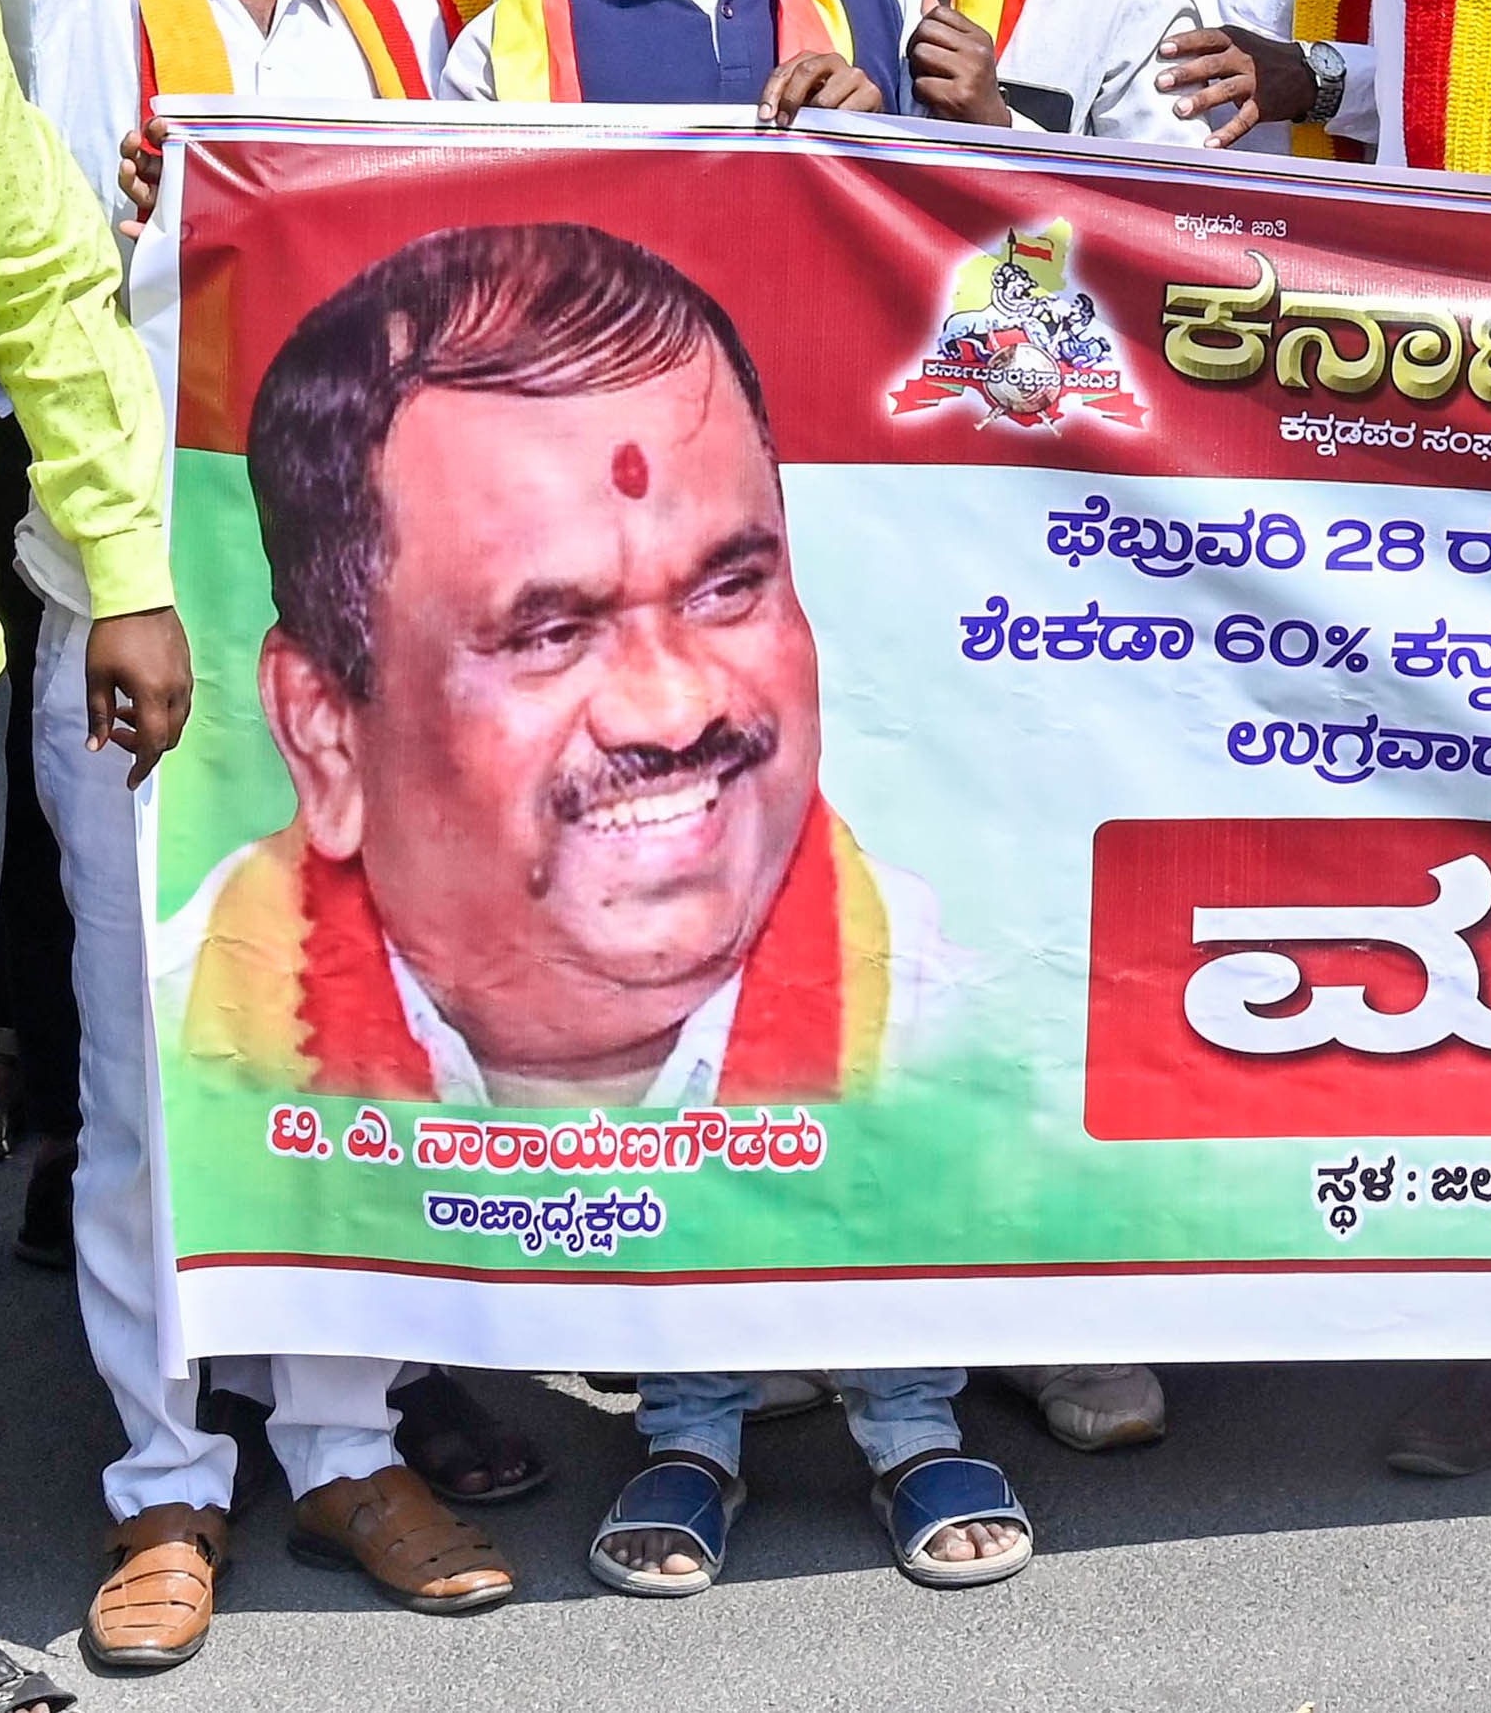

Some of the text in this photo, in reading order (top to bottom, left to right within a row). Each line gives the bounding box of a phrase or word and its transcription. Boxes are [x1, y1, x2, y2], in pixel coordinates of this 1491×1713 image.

[1174, 213, 1287, 240] ಕನ್ನಡವೇ ಜಾತಿ
[925, 361, 1003, 383] ಕರ್ನಾಟಕ
[1280, 413, 1415, 456] ಕನ್ನಡಪರ
[1046, 495, 1307, 578] ಫೆಬ್ರುವರಿ
[1324, 519, 1426, 573] 28
[960, 595, 1196, 662] ಶೇಕಡಾ
[1213, 613, 1372, 673] 60%
[273, 1108, 328, 1155] ಟಿ.
[419, 1109, 820, 1171] ನಾರಾಯಣಗೌಡರು
[428, 1190, 663, 1254] ರಾಜ್ಯಾಧ್ಯಕ್ಷರು
[1317, 1155, 1396, 1235] ಸ್ಥಳ
